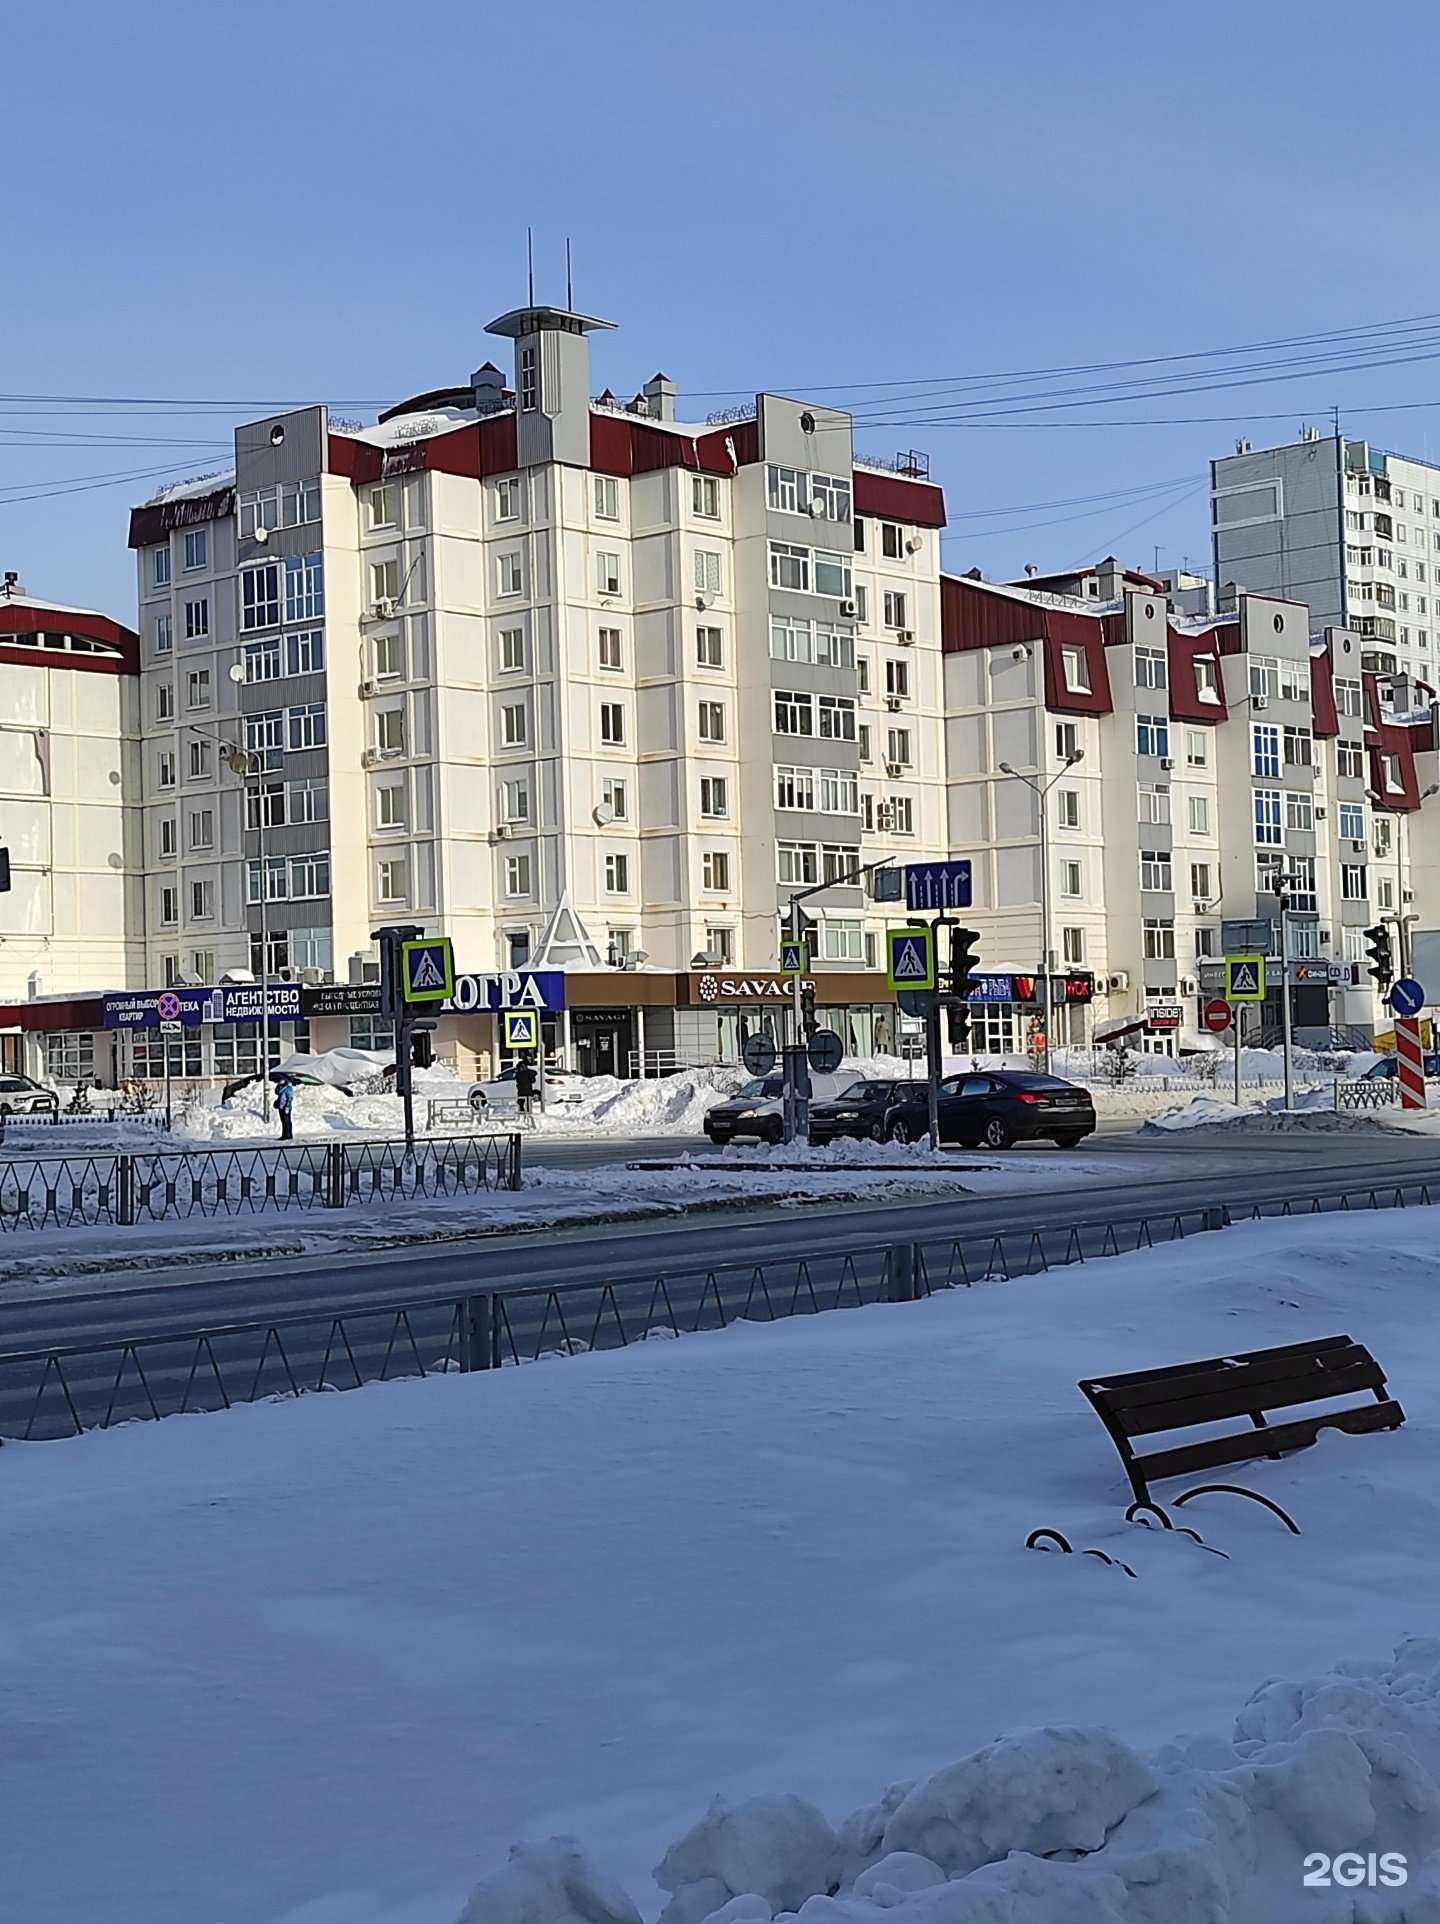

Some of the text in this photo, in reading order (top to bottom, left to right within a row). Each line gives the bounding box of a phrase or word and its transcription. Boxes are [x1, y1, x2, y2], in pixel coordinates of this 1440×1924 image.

[226, 989, 299, 1005] АГЕНТСТВО
[106, 997, 159, 1011] ОГРОМНЫЙ ВЫБОР
[226, 1004, 300, 1017] НЕДВИЖМОСТИ
[119, 1012, 144, 1021] КВАРТИР
